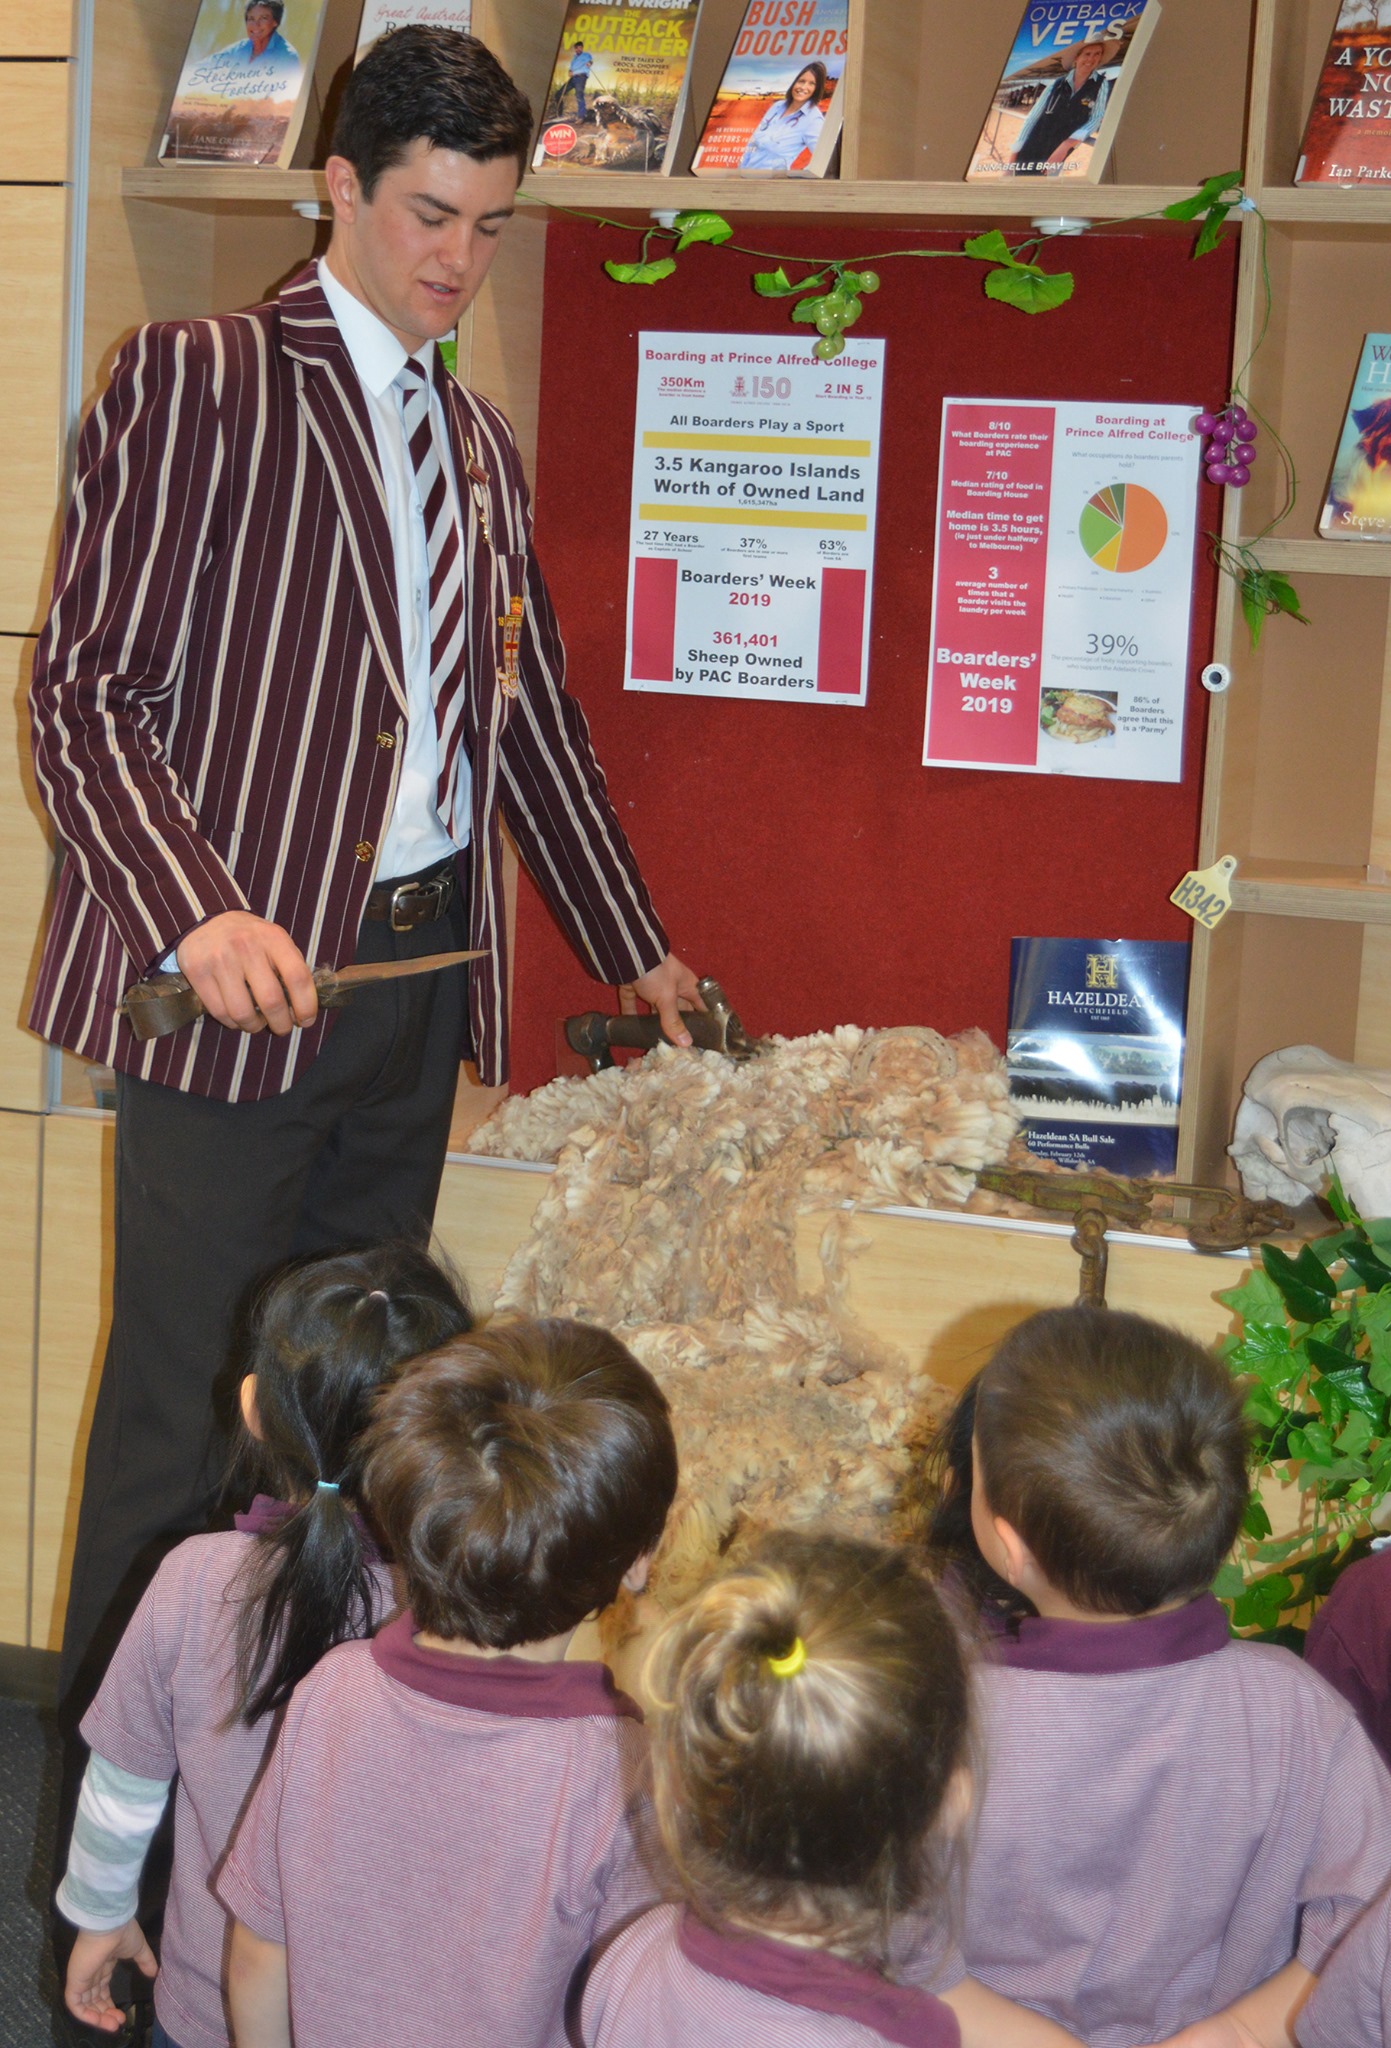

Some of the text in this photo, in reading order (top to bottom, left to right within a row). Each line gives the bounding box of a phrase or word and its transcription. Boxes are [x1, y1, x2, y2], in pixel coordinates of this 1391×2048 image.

[624, 9, 641, 18] THE
[746, 0, 817, 27] BUSH
[1030, 2, 1142, 23] OUTBACK
[574, 14, 686, 38] OUTBACK
[1031, 18, 1128, 47] VETS
[562, 32, 689, 57] WRANGLER
[735, 29, 848, 56] DOCTORS
[1334, 47, 1352, 66] A
[187, 62, 275, 87] Stockmen's
[211, 80, 288, 100] Footsteps
[550, 129, 572, 139] WIN
[975, 162, 1082, 172] ANNABELLE BRAYLEY
[1328, 164, 1353, 178] Ian
[645, 349, 706, 365] Boarding
[711, 353, 724, 363] at
[728, 352, 773, 364] Prince
[777, 354, 820, 366] Alfred
[660, 377, 705, 388] 350Km
[752, 376, 792, 400] 150
[824, 383, 864, 395] 2 IN 5
[670, 415, 845, 434] All Boarders Play a Sport
[989, 422, 1011, 431] 8/10
[1095, 415, 1166, 428] Boarding at
[973, 431, 1009, 439] Boarders
[1065, 427, 1194, 443] Prince Alfred College
[959, 440, 1039, 450] boarding experience
[654, 456, 861, 480] 3.5 Kangaroo Islands
[986, 471, 1008, 480] 7/10
[654, 478, 865, 503] Worth of Owned Land
[951, 480, 979, 488] Median
[981, 481, 1004, 490] rating
[1016, 482, 1034, 490] food
[966, 490, 1029, 499] Boarding House
[737, 499, 778, 507] 1,615,347ha
[946, 510, 1044, 524] Median time to get
[1341, 510, 1386, 528] Steve
[949, 522, 1043, 535] home is 3.5 hours,
[643, 530, 699, 543] 27 Years
[740, 537, 767, 549] 37%
[954, 532, 965, 540] (ie
[966, 532, 982, 541] just
[1007, 535, 1039, 544] halfway
[819, 539, 847, 551] 63%
[979, 542, 1023, 552] Melbourne)
[681, 569, 816, 590] Boarders' Week
[988, 566, 998, 580] 3
[955, 581, 1028, 590] average number of
[729, 592, 771, 607] 2019
[968, 589, 990, 597] times
[957, 597, 1026, 607] Boarder visits the
[959, 606, 1026, 616] laundry per week
[712, 631, 778, 648] 361,401
[1086, 633, 1139, 657] 39%
[688, 649, 803, 668] Sheep Owned
[936, 648, 1037, 669] Boarders'
[675, 667, 815, 689] by PAC Boarders
[959, 672, 1017, 691] Week
[961, 696, 1013, 715] 2019
[1130, 705, 1165, 714] Boarders
[1173, 876, 1225, 926] H342
[1047, 991, 1155, 1008] HAZELDEA
[1073, 1007, 1129, 1016] LITCHFIELD
[1028, 1131, 1115, 1144] Hazeldean SA Bull Sale
[1037, 1141, 1073, 1149] Performance
[1050, 1151, 1073, 1159] February
